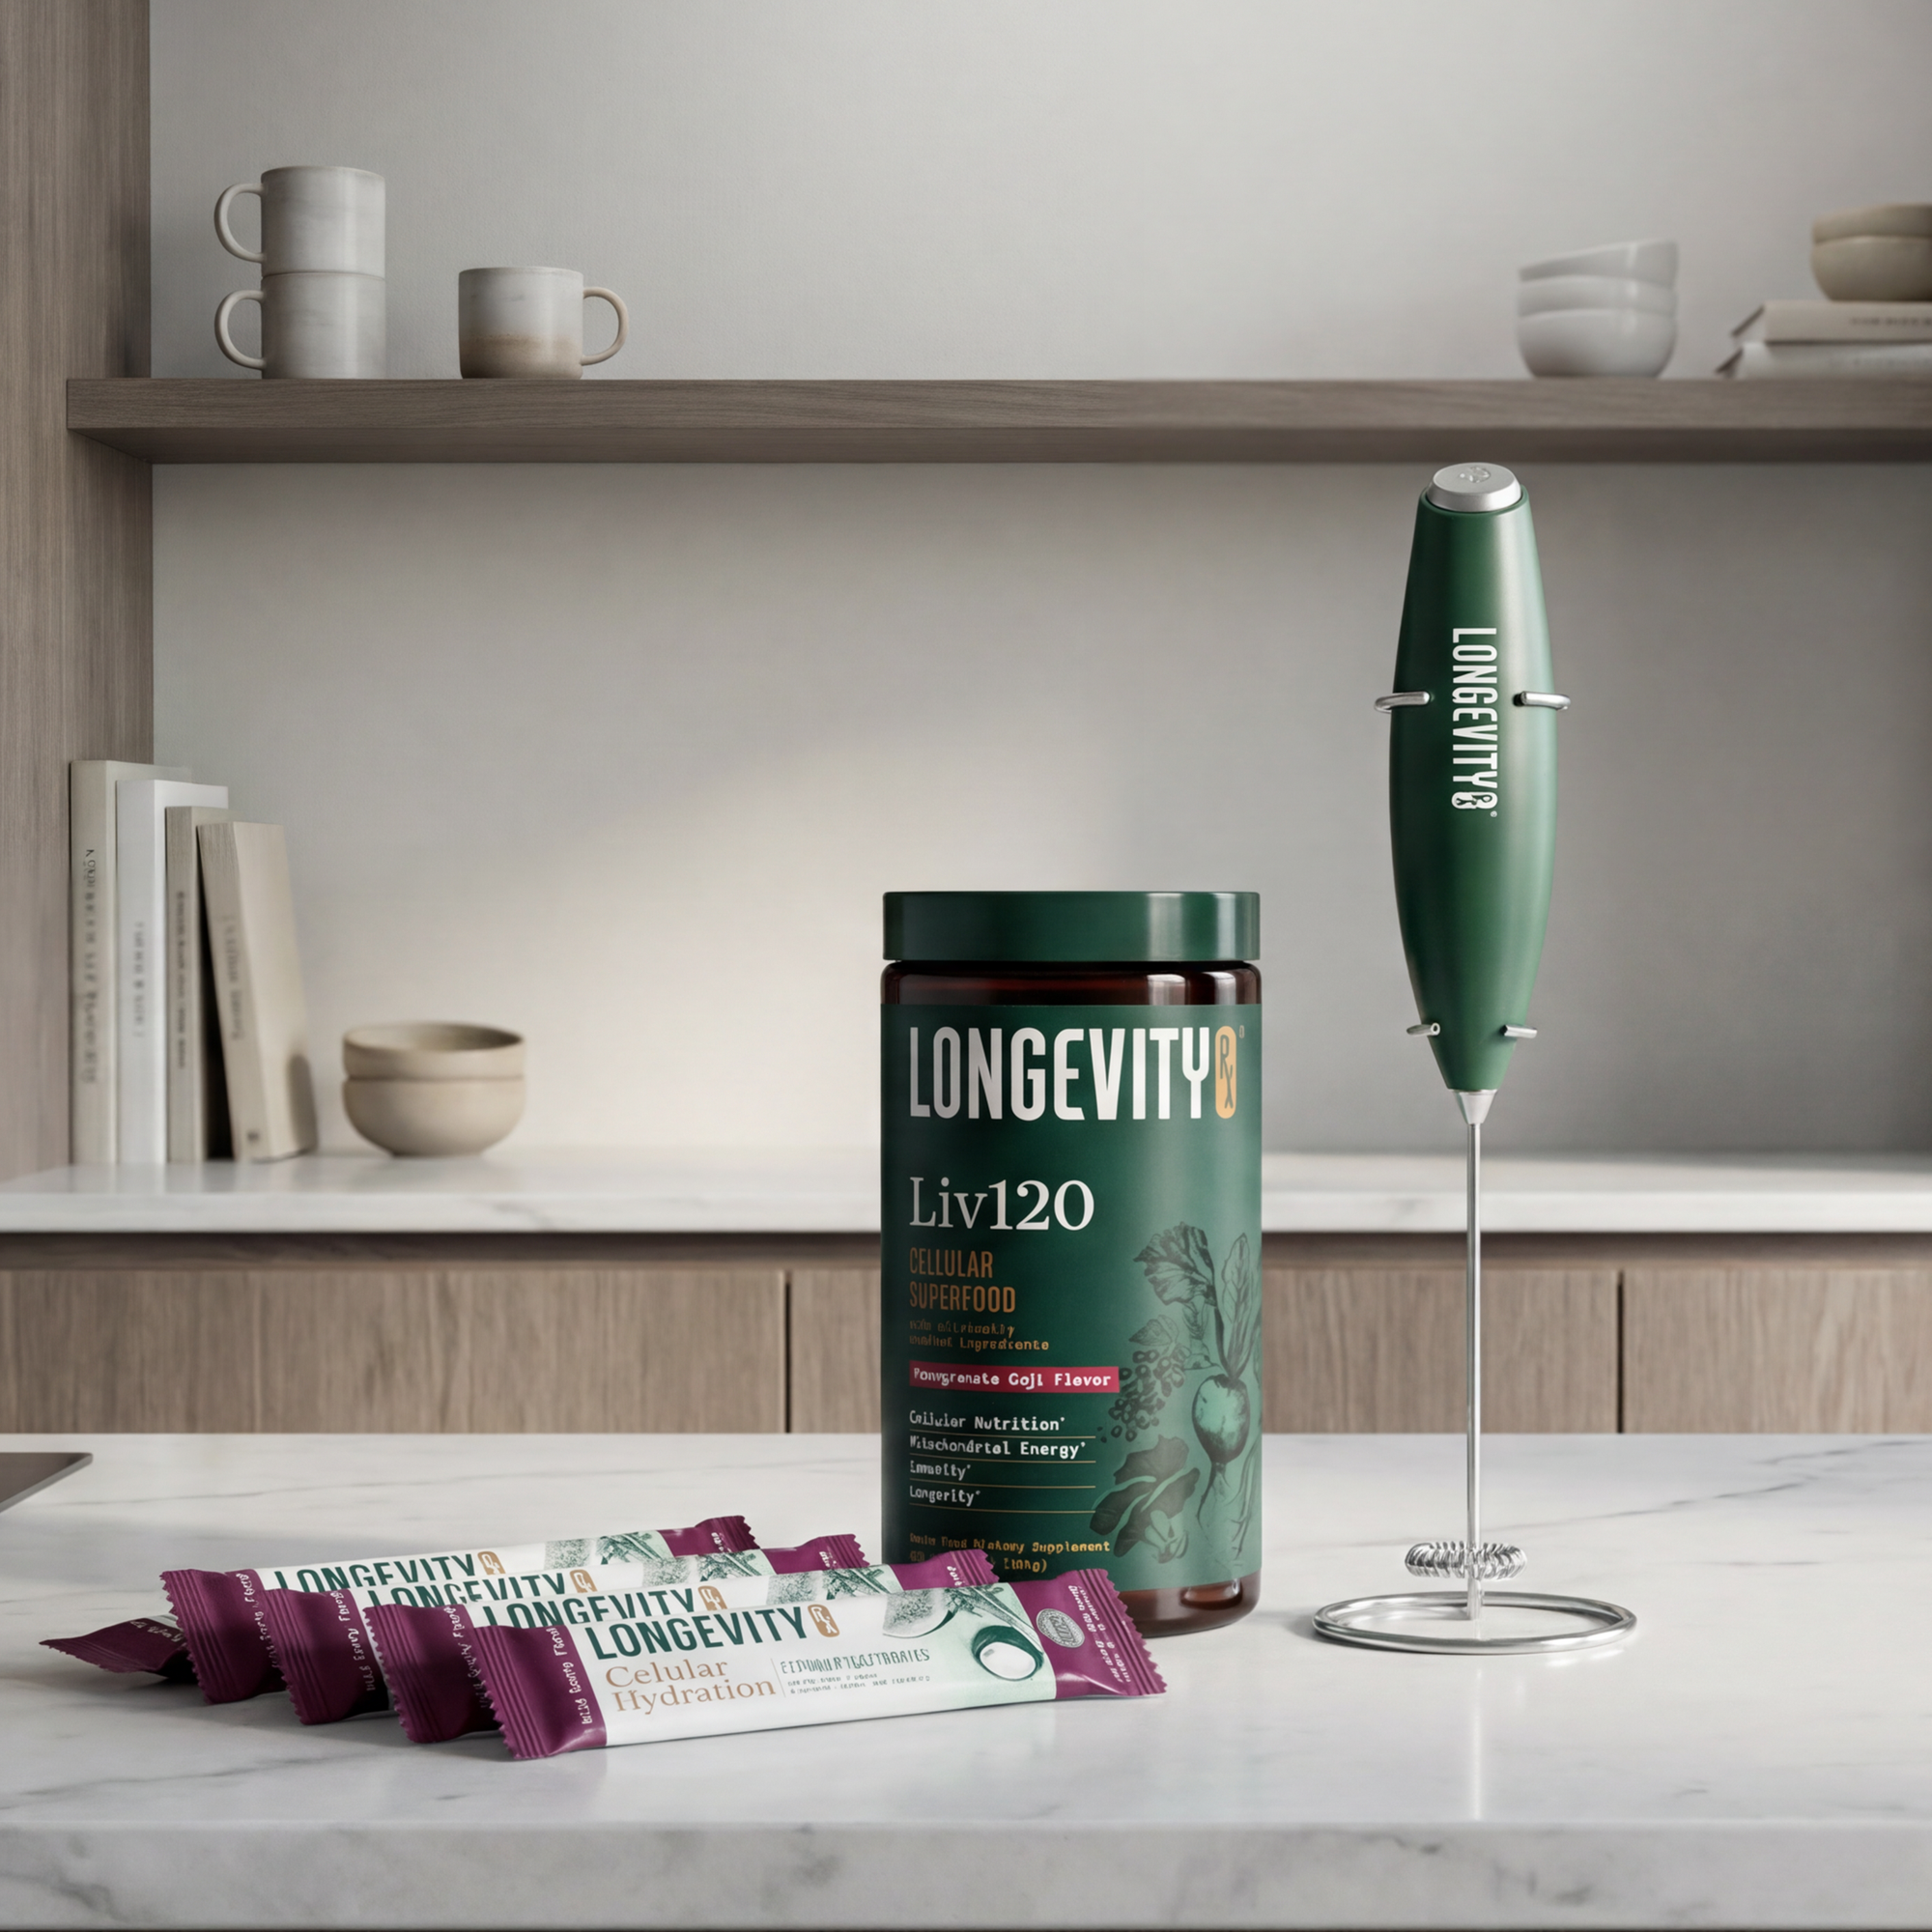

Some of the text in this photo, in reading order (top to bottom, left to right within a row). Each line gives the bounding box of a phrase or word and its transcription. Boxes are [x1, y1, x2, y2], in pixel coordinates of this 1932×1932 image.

[1452, 627, 1498, 789] LONGEVITY
[910, 1026, 1209, 1121] LONGEVITY
[909, 1177, 1094, 1231] Liv120
[909, 1247, 993, 1278] CELLULAR
[909, 1281, 1015, 1313] SUPERFOOD
[584, 1605, 808, 1660] LONGEVITY
[605, 1658, 727, 1688] Celular
[611, 1678, 777, 1715] Hydration
